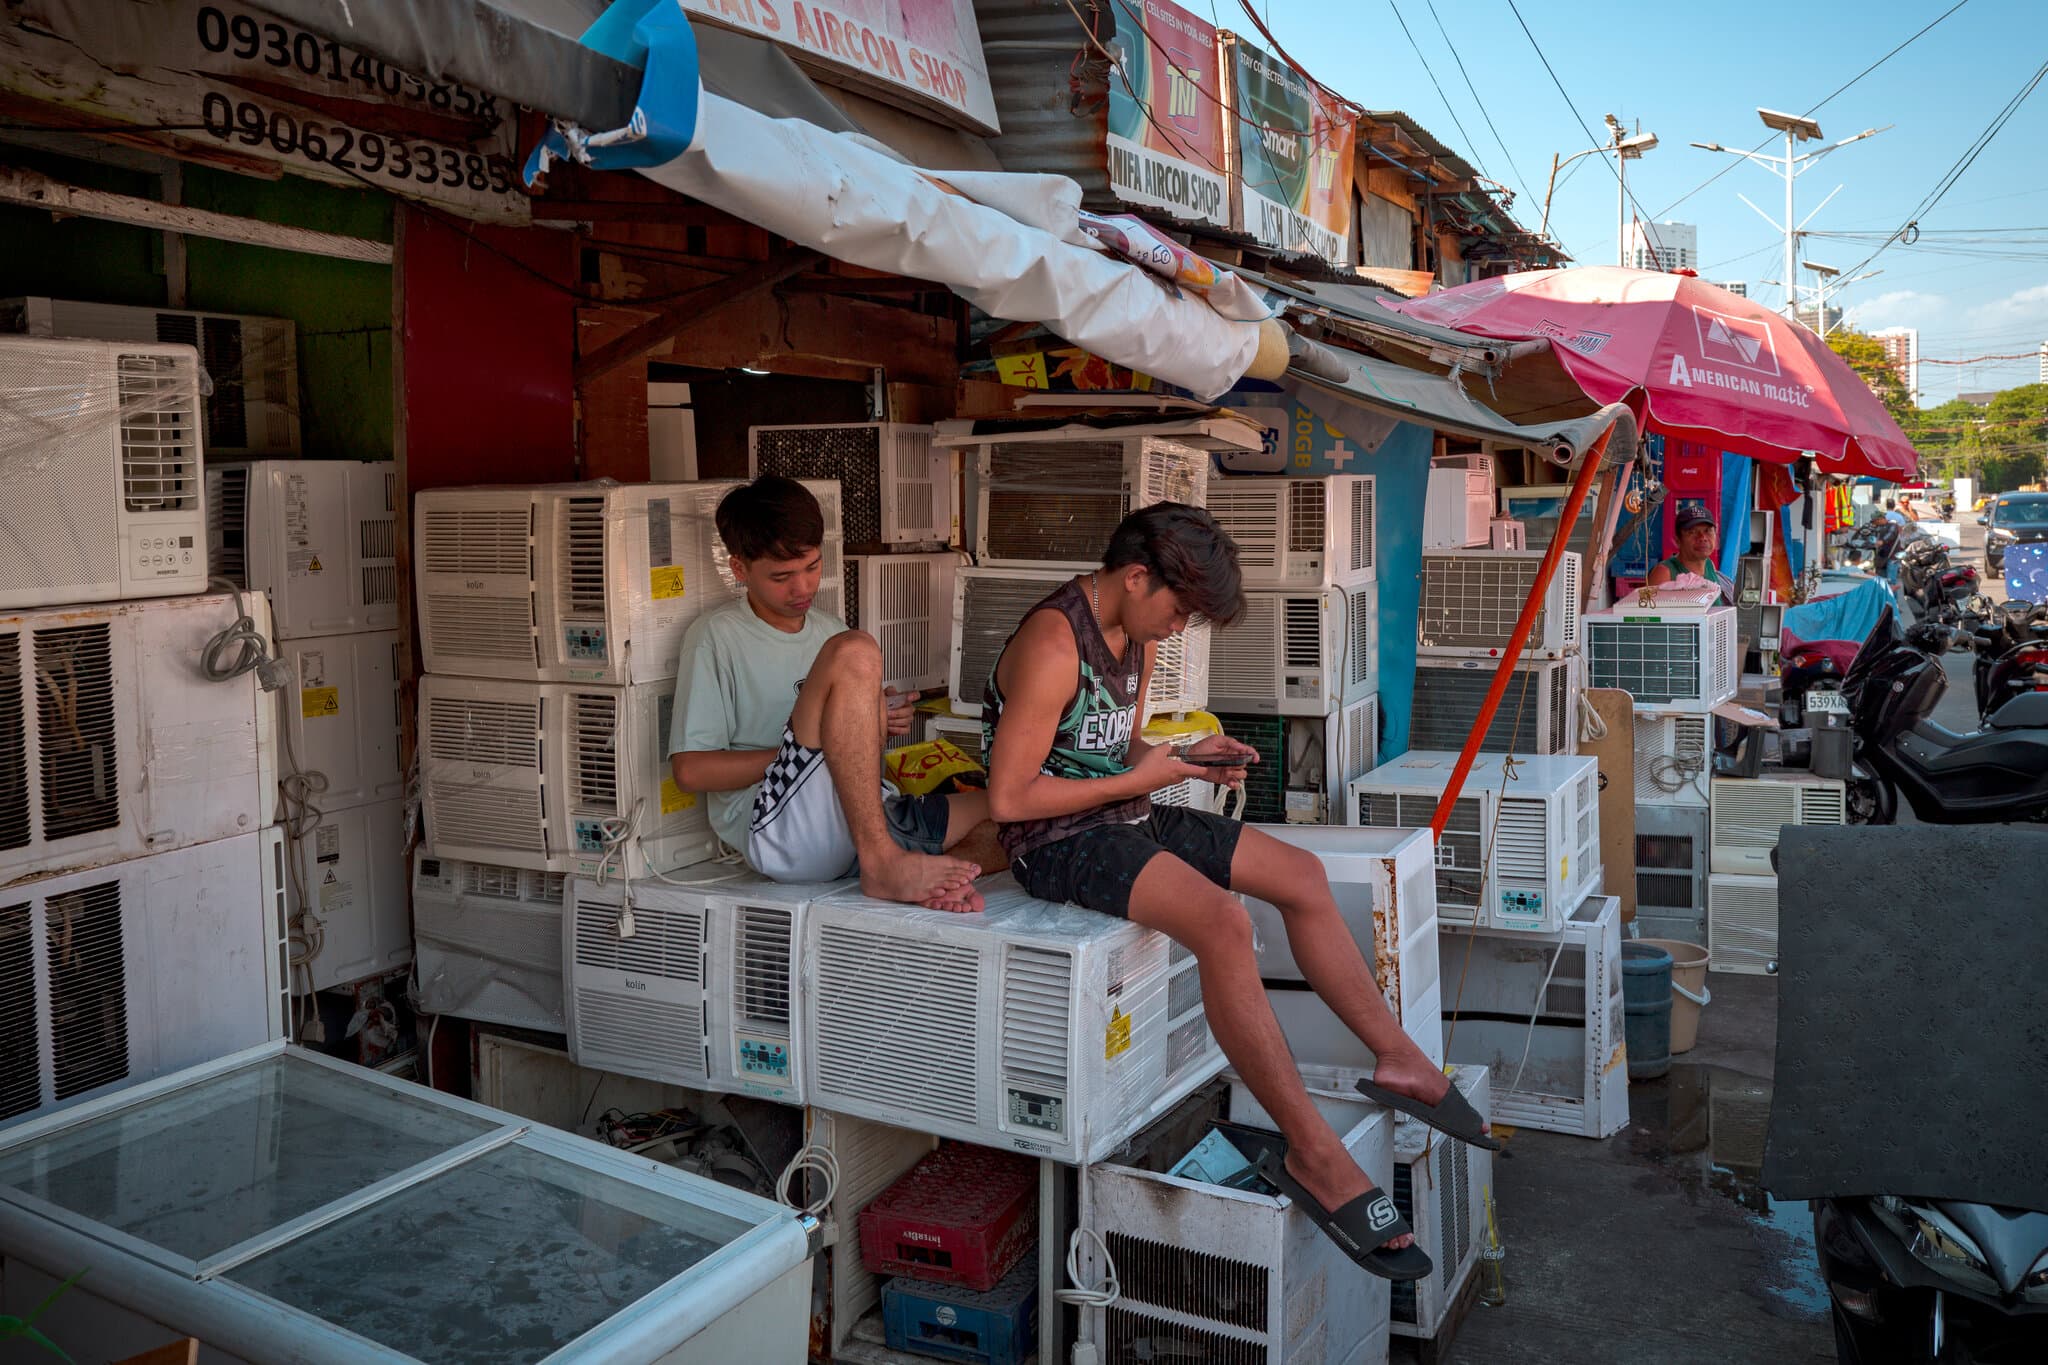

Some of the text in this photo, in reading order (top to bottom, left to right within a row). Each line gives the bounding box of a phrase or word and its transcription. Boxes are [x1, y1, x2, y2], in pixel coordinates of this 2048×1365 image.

[793, 0, 906, 80] AIRCON
[909, 47, 968, 106] SHOP
[1198, 31, 1214, 49] AREA
[1240, 51, 1254, 70] STAY
[1166, 63, 1201, 118] TNT
[1262, 120, 1297, 161] Smart
[1144, 158, 1189, 206] AIRCON
[1190, 173, 1221, 218] SHOP
[1669, 354, 1811, 408] AMERICAN matic
[1294, 406, 1314, 469] 20GB
[625, 977, 646, 991] kolin
